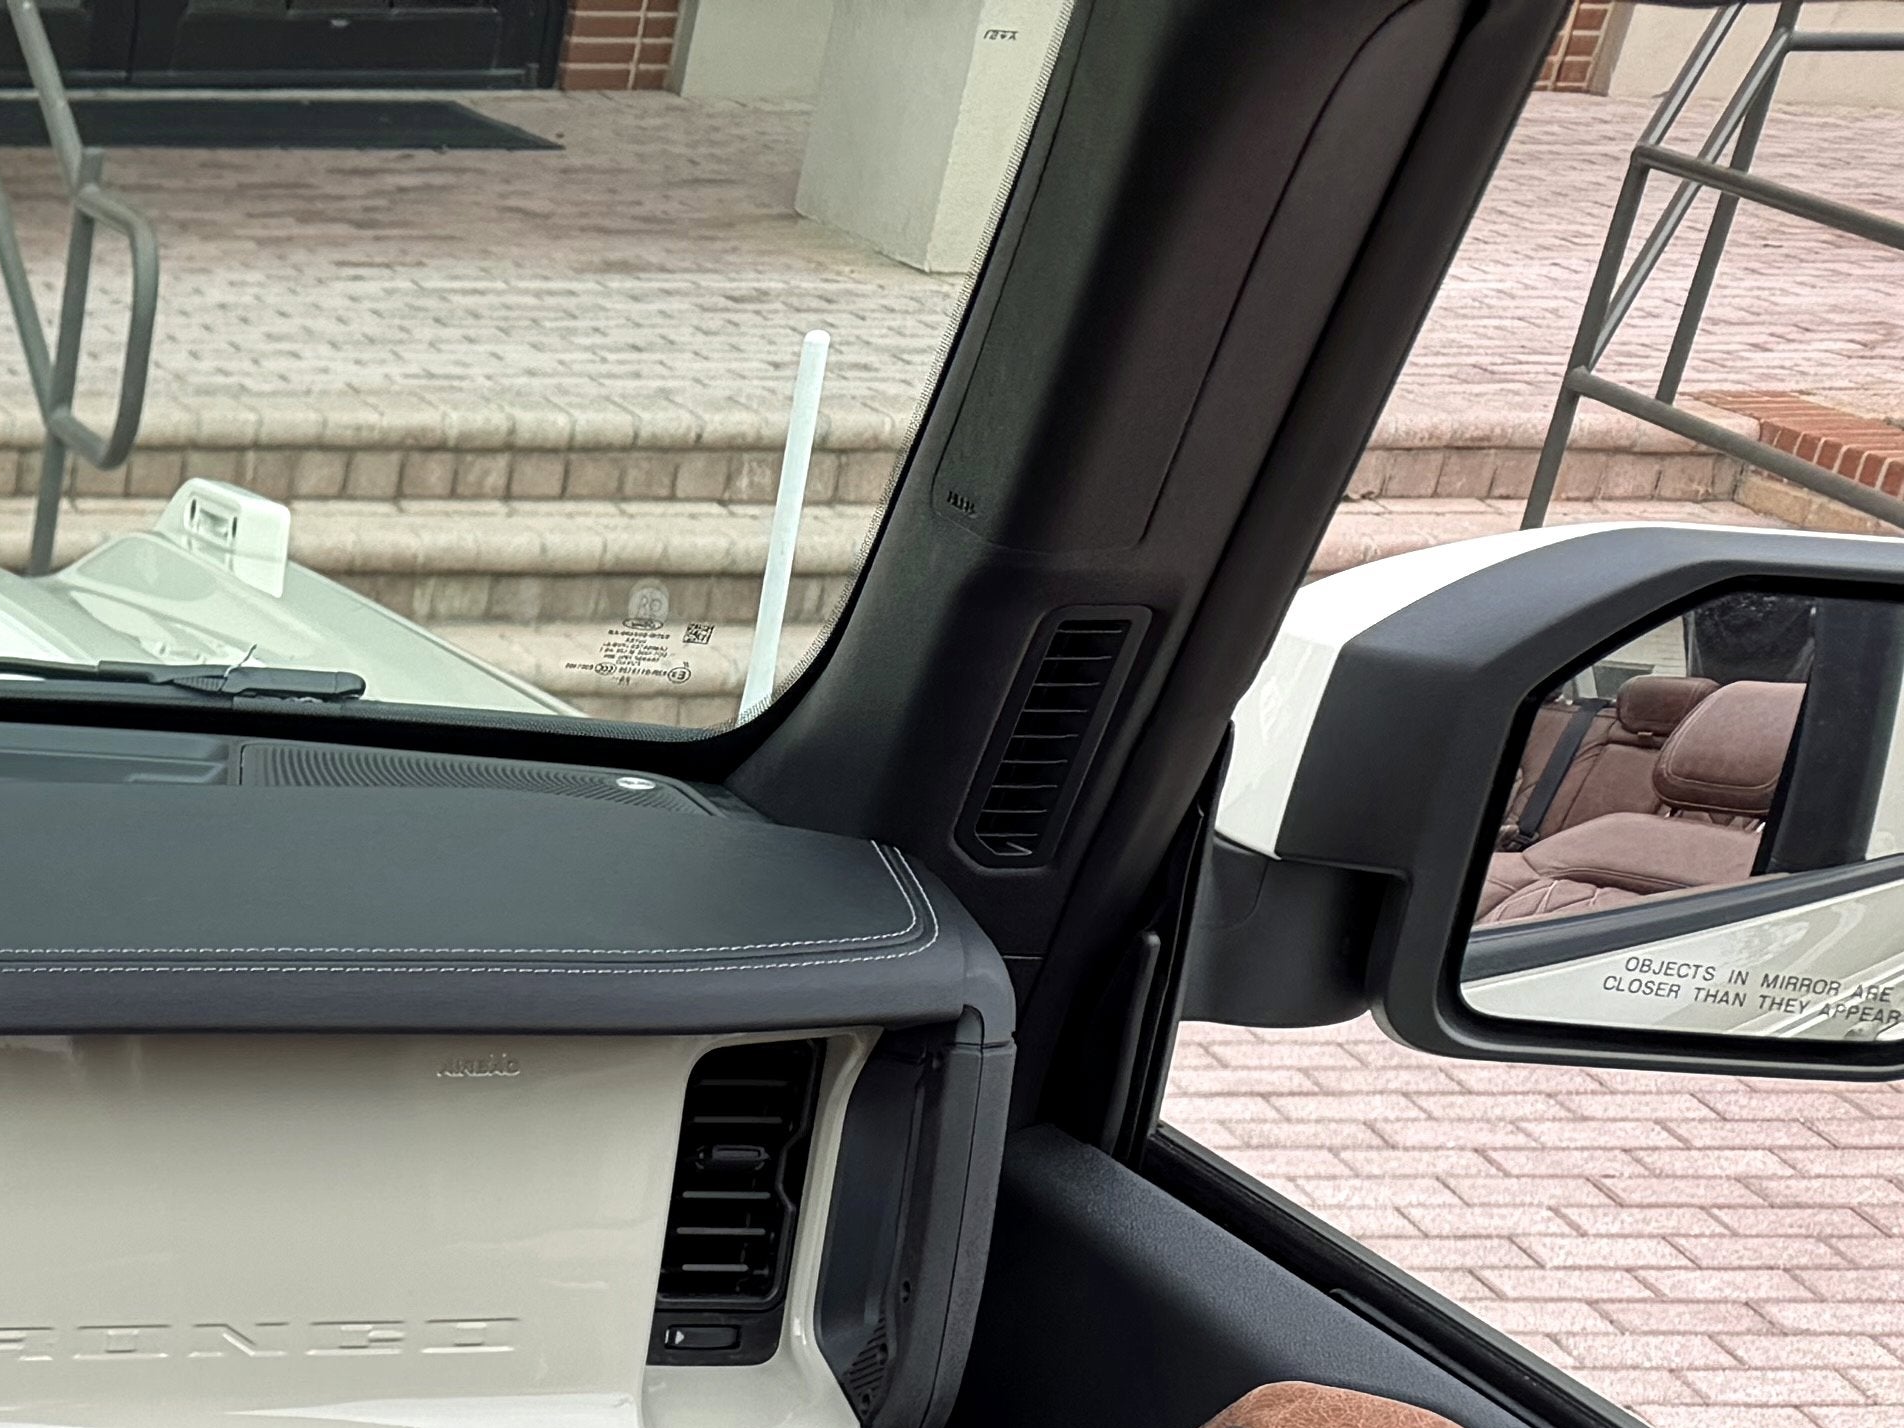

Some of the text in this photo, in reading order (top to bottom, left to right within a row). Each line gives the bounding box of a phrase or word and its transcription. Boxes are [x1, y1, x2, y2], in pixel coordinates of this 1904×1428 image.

[1602, 975, 1902, 1024] CLOSER THAN THEY APPEAR
[1625, 957, 1895, 1003] OBJECTS IN MIRROR ARE
